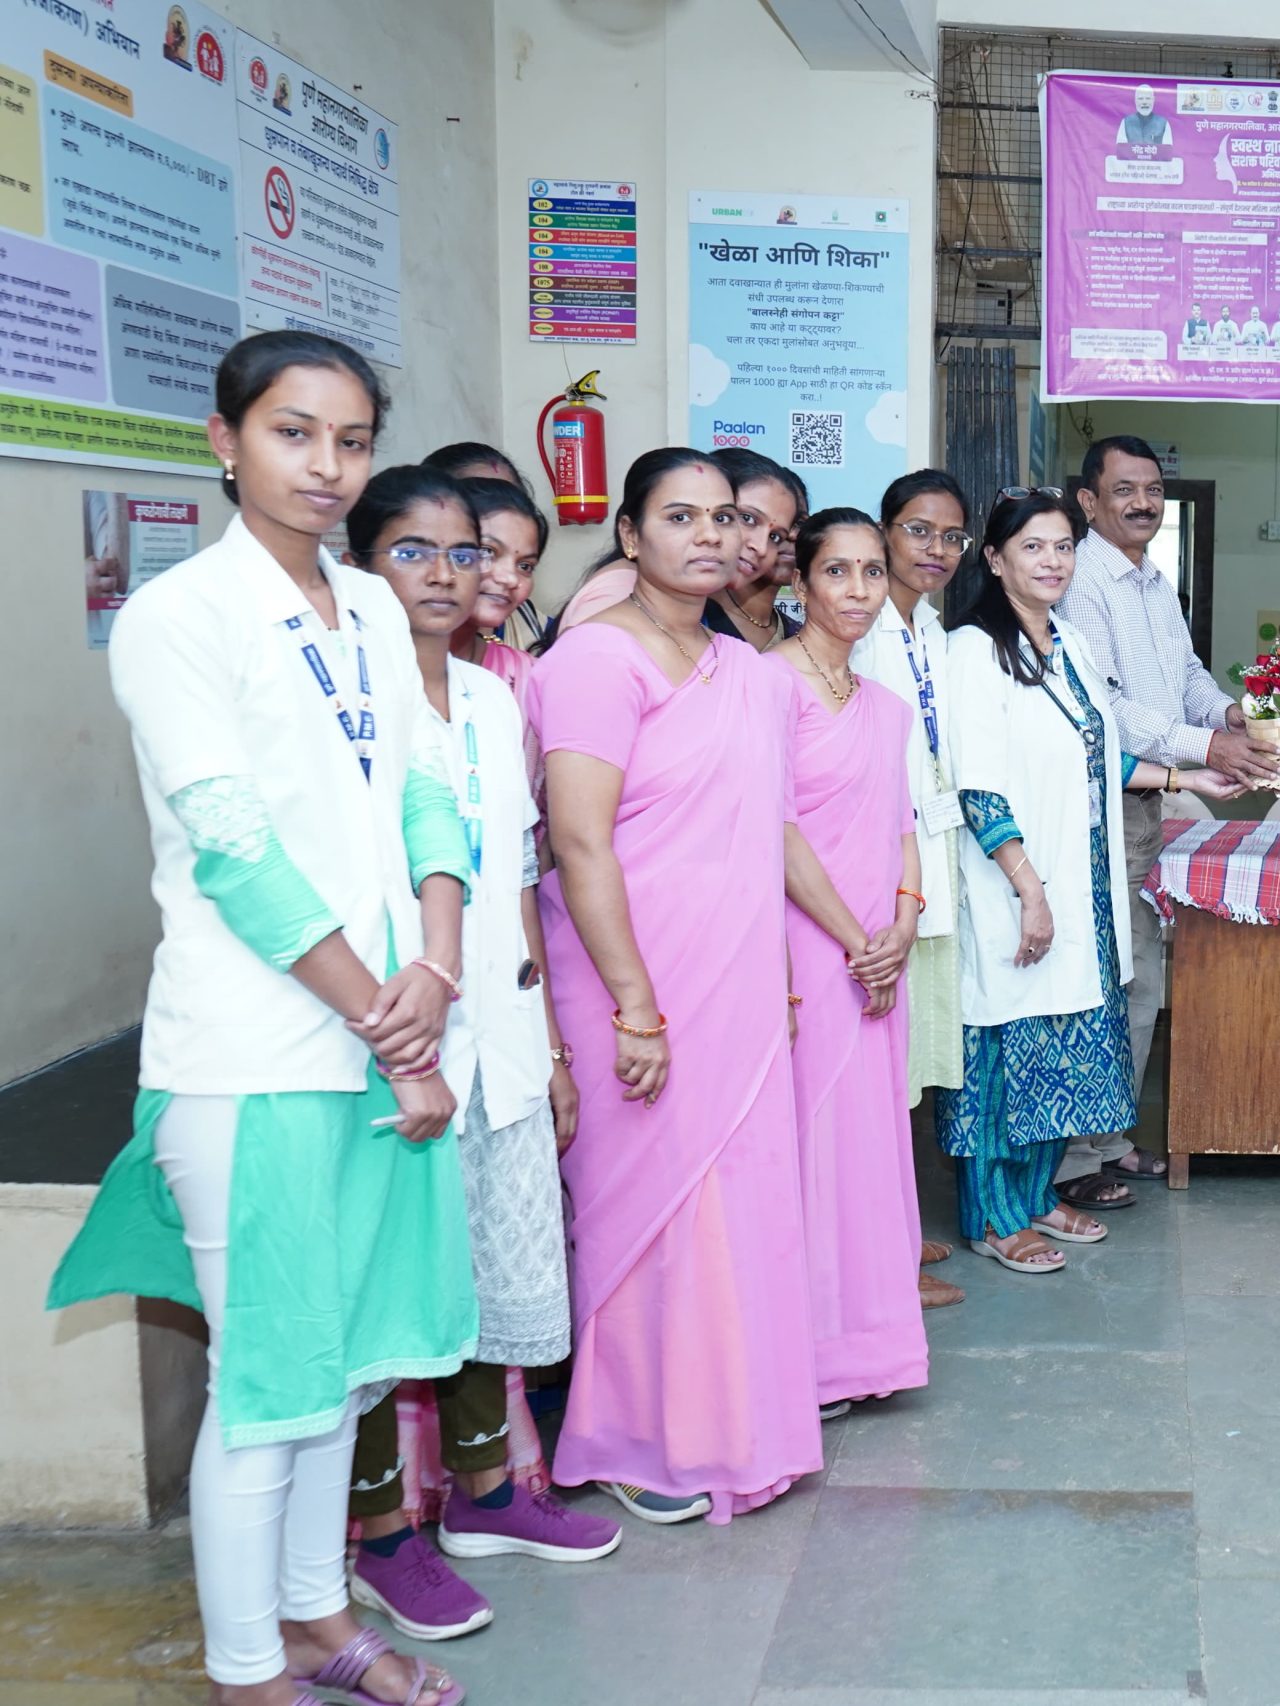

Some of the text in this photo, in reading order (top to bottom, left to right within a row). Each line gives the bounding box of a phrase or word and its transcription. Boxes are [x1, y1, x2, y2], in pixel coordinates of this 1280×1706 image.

[302, 81, 368, 135] पुणे महानगरपालिका
[1196, 120, 1209, 132] पुणे
[1211, 120, 1266, 133] महानगरपालिका,
[312, 116, 357, 154] आरोग्य विभाग
[1231, 138, 1261, 153] स्वस्थ
[197, 167, 216, 187] DBT
[699, 239, 890, 268] "खेळा आणि शिका"
[707, 278, 884, 293] आता दवाखान्यात ही मुलांना खेळण्या-शिकण्याची
[748, 292, 764, 302] संधी
[766, 295, 795, 304] उपलब्ध
[822, 296, 844, 306] देणारा
[791, 309, 820, 319] संगोपन
[750, 322, 797, 332] काय आहे या
[726, 336, 743, 344] चला
[759, 338, 779, 346] एकदा
[782, 337, 818, 348] मुलांसोबत
[737, 362, 763, 372] पहिल्या
[790, 364, 821, 375] दिवसांची
[823, 366, 847, 376] माहिती
[731, 377, 750, 385] पालन
[790, 380, 808, 389] App
[810, 379, 827, 389] साठी
[830, 381, 837, 389] हा
[840, 381, 854, 390] QR
[857, 382, 872, 390] कोड
[713, 420, 766, 434] Paalan
[713, 435, 750, 447] 1000
